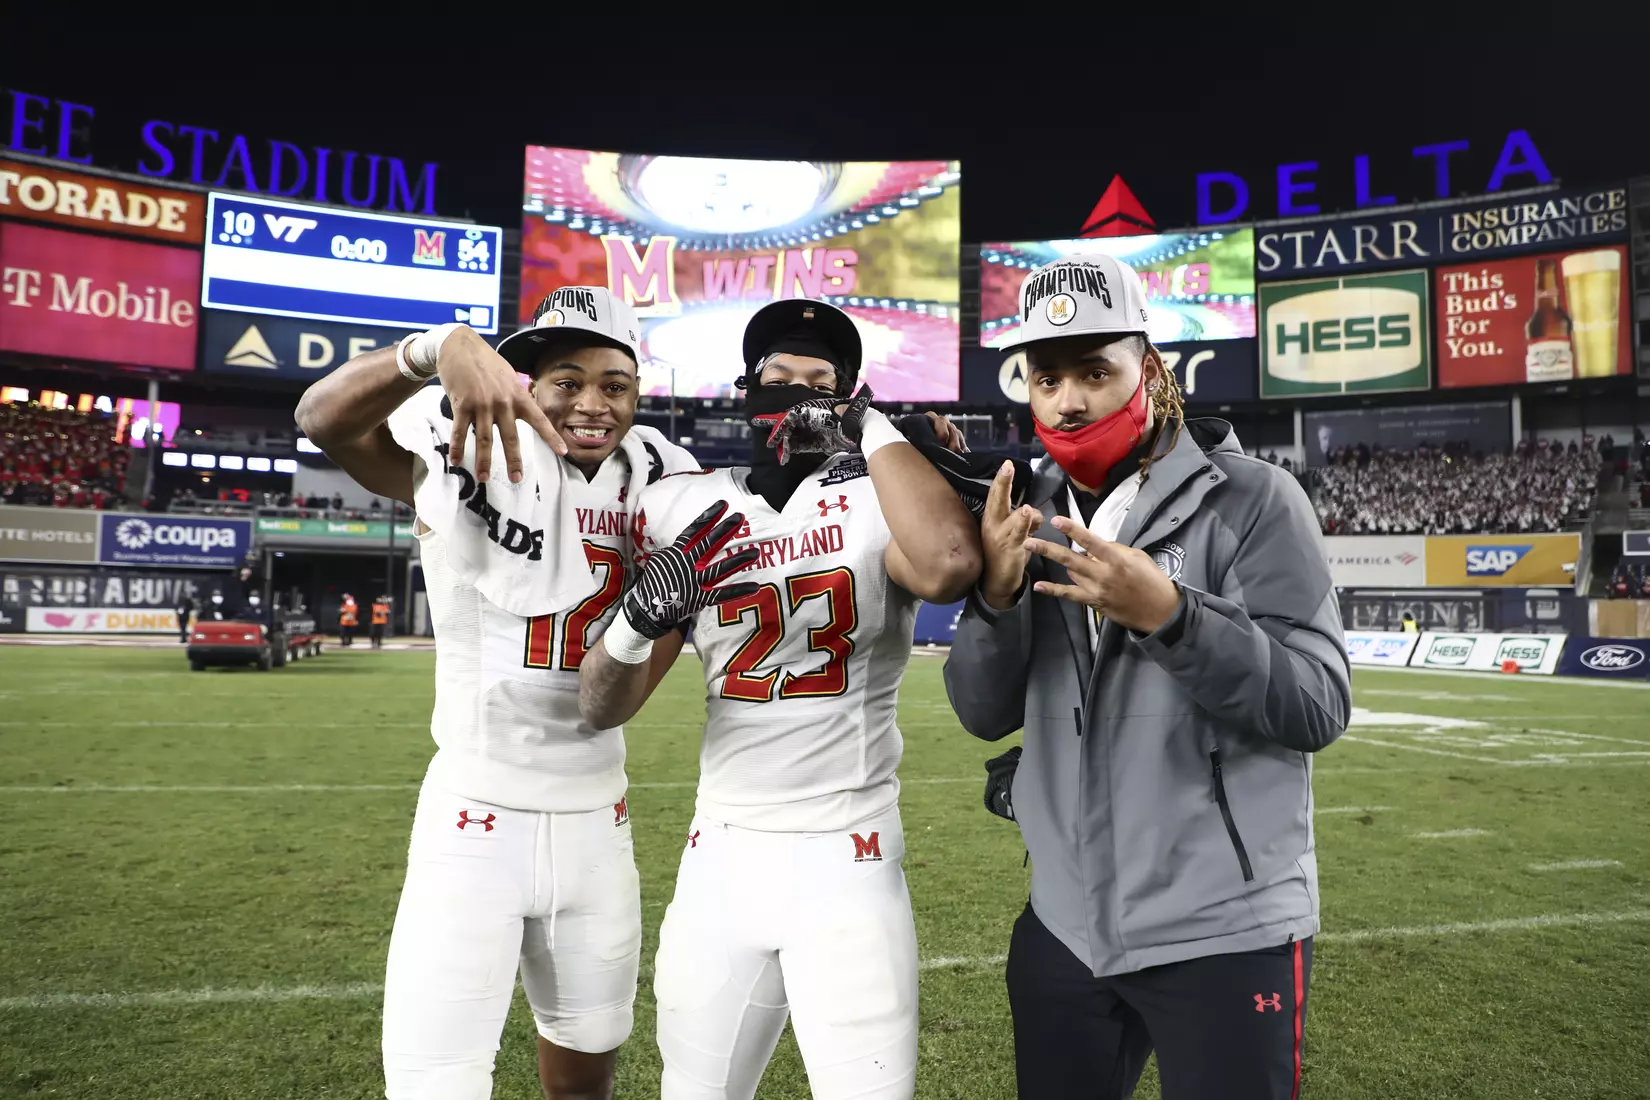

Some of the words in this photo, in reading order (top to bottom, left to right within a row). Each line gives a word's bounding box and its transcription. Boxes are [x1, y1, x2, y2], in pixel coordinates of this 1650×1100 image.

[6, 89, 96, 166] EE
[138, 119, 440, 215] STADIUM
[1196, 129, 1554, 225] DELTA
[1451, 188, 1627, 233] INSURANCE
[222, 210, 256, 236] 10
[263, 213, 318, 243] VT
[1451, 210, 1627, 253] COMPANIES
[331, 235, 387, 263] 0:00
[457, 238, 490, 262] 54
[1257, 220, 1431, 272] STARR
[702, 247, 859, 300] WINS
[1443, 269, 1504, 293] This
[48, 272, 194, 328] Mobile
[1024, 267, 1112, 322] CHAMPIONS
[1444, 289, 1517, 316] Bud's
[1275, 314, 1412, 355] HESS
[1446, 315, 1491, 337] For
[1445, 337, 1503, 358] You.
[31, 529, 94, 545] HOTELS
[154, 524, 236, 552] coupa
[1164, 541, 1186, 559] BOWL
[1337, 555, 1392, 566] AMERICA
[1466, 548, 1519, 574] SAP
[107, 613, 197, 630] DUNK
[717, 566, 859, 703] 23
[1432, 645, 1470, 657] HESS
[1500, 647, 1541, 659] HESS
[1590, 646, 1632, 667] Ford
[849, 831, 882, 858] M
